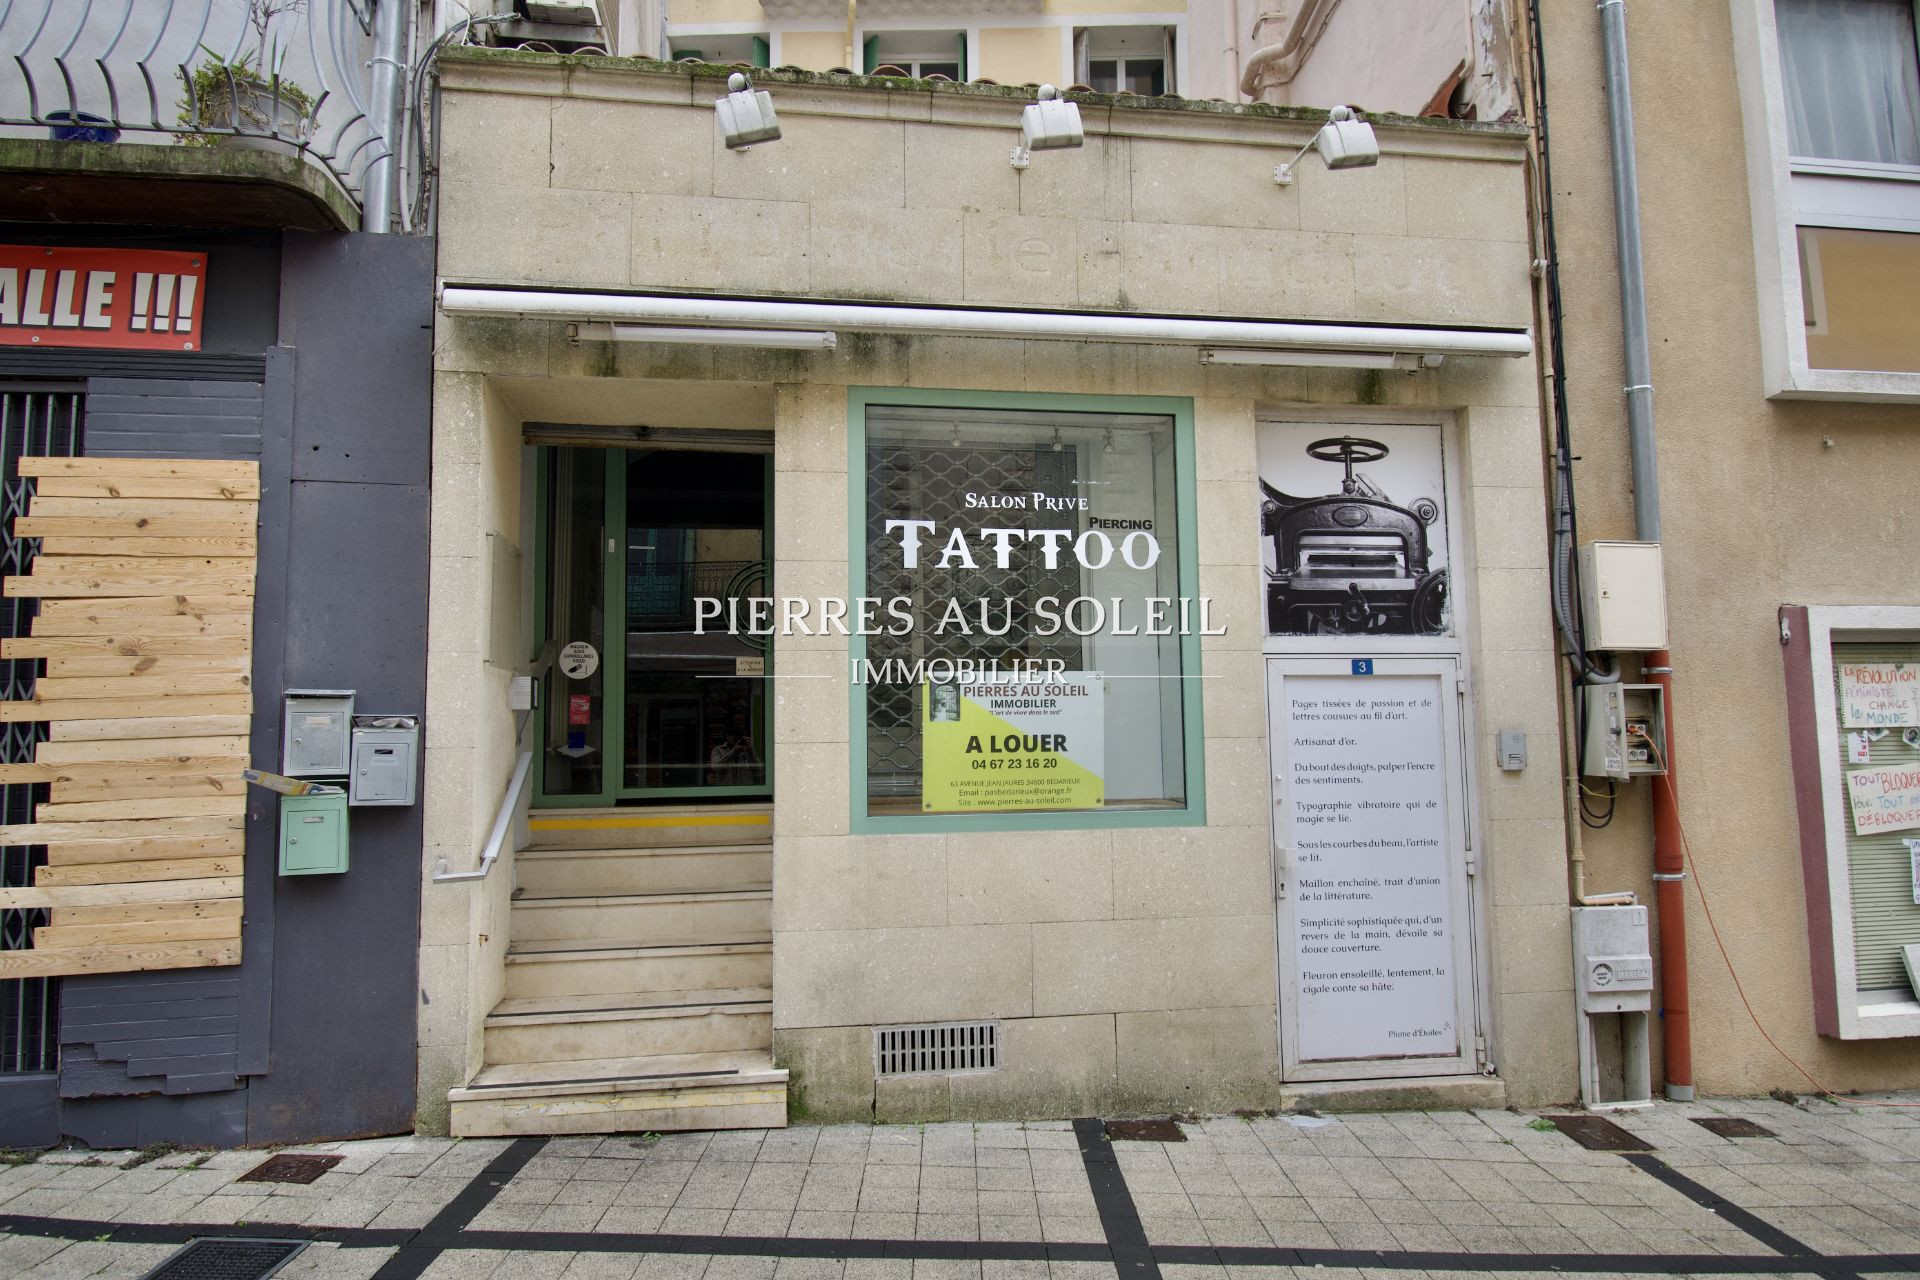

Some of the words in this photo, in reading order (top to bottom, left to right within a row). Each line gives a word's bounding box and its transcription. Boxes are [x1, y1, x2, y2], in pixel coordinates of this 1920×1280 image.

[1089, 517, 1152, 530] PIERCING
[886, 520, 1162, 570] TATTOO
[1359, 662, 1366, 672] 3
[1845, 667, 1855, 676] LA
[1856, 667, 1916, 684] RÉVOLUTION
[964, 686, 1017, 697] PIERRES
[1021, 686, 1039, 697] AU
[1044, 686, 1088, 696] SOLEIL
[991, 699, 1056, 708] IMMOBILIER
[1292, 700, 1317, 710] Pages
[1356, 700, 1366, 708] de
[1371, 700, 1404, 710] passion
[1870, 700, 1909, 710] CHANGE
[1851, 703, 1862, 718] le
[1867, 712, 1908, 724] MONDE
[966, 736, 982, 753] A
[991, 735, 1068, 753] LOUER
[972, 760, 986, 769] 04
[990, 760, 1004, 769] 67
[1008, 759, 1022, 768] 23
[1026, 759, 1039, 768] 16
[1043, 759, 1056, 768] 20
[1347, 763, 1376, 773] doigts,
[1378, 762, 1405, 773] palper
[1852, 773, 1880, 786] TOUT
[985, 788, 1072, 797] pasbedarieux@orange.fr
[978, 797, 1071, 806] www.pierres-au-soleil.com
[1296, 801, 1352, 812] Typographie
[1406, 801, 1420, 811] qui
[1877, 795, 1904, 809] TOUT
[1297, 814, 1324, 825] magie
[1298, 841, 1318, 849] Sous
[1333, 840, 1367, 848] courbes
[1381, 839, 1405, 848] beau,
[1338, 878, 1380, 887] enchaîné,
[1300, 918, 1345, 929] Simplicité
[1347, 917, 1402, 928] sophistiquée
[1405, 917, 1421, 927] qui,
[1302, 945, 1328, 953] douce
[1340, 971, 1384, 980] ensoleillé,
[1388, 969, 1434, 978] lentement,
[1304, 985, 1329, 995] cigale
[1372, 983, 1394, 991] hâte.
[1413, 1028, 1442, 1037] d'Étoiles
